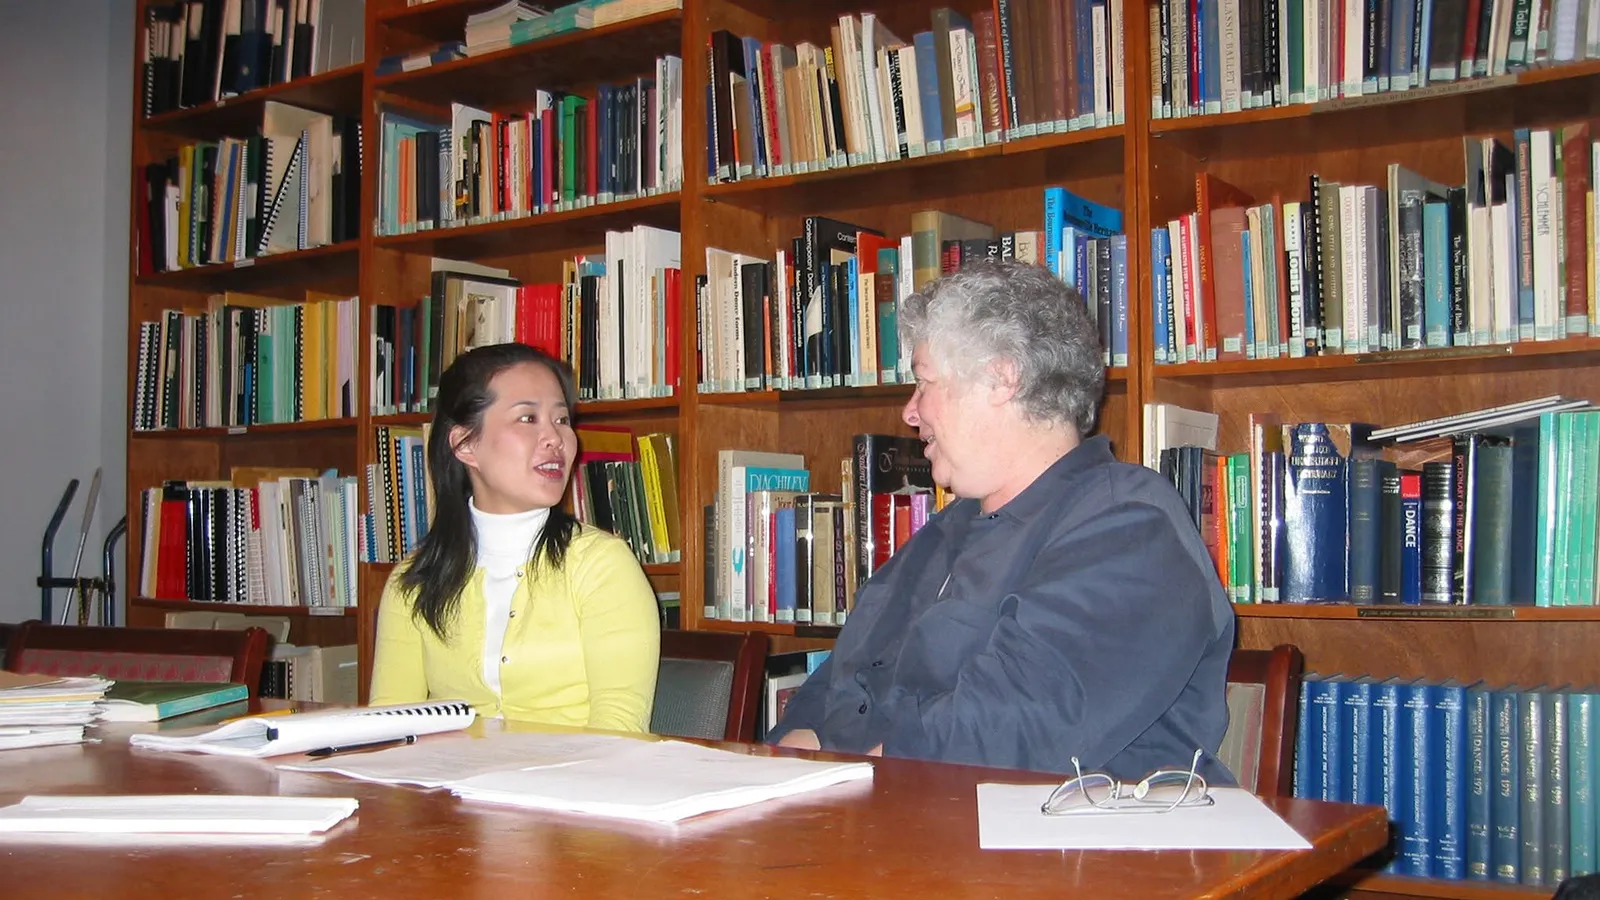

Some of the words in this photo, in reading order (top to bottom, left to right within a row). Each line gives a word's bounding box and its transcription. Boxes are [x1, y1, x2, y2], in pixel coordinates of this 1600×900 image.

[1514, 9, 1529, 36] Table
[1002, 39, 1011, 68] Making
[1225, 42, 1238, 84] BALLET
[805, 218, 814, 272] Contemporary
[1453, 236, 1461, 248] The
[1288, 250, 1300, 293] Louis
[806, 272, 815, 299] Dance
[1454, 287, 1463, 304] Book
[1290, 294, 1302, 337] Horst
[1455, 455, 1465, 499] DICTIONARY
[1456, 501, 1464, 511] OF
[1405, 509, 1416, 548] DANCE
[1456, 514, 1464, 527] THE
[1456, 529, 1464, 553] DANCE
[1473, 777, 1483, 796] 1979
[1500, 780, 1511, 798] 1979
